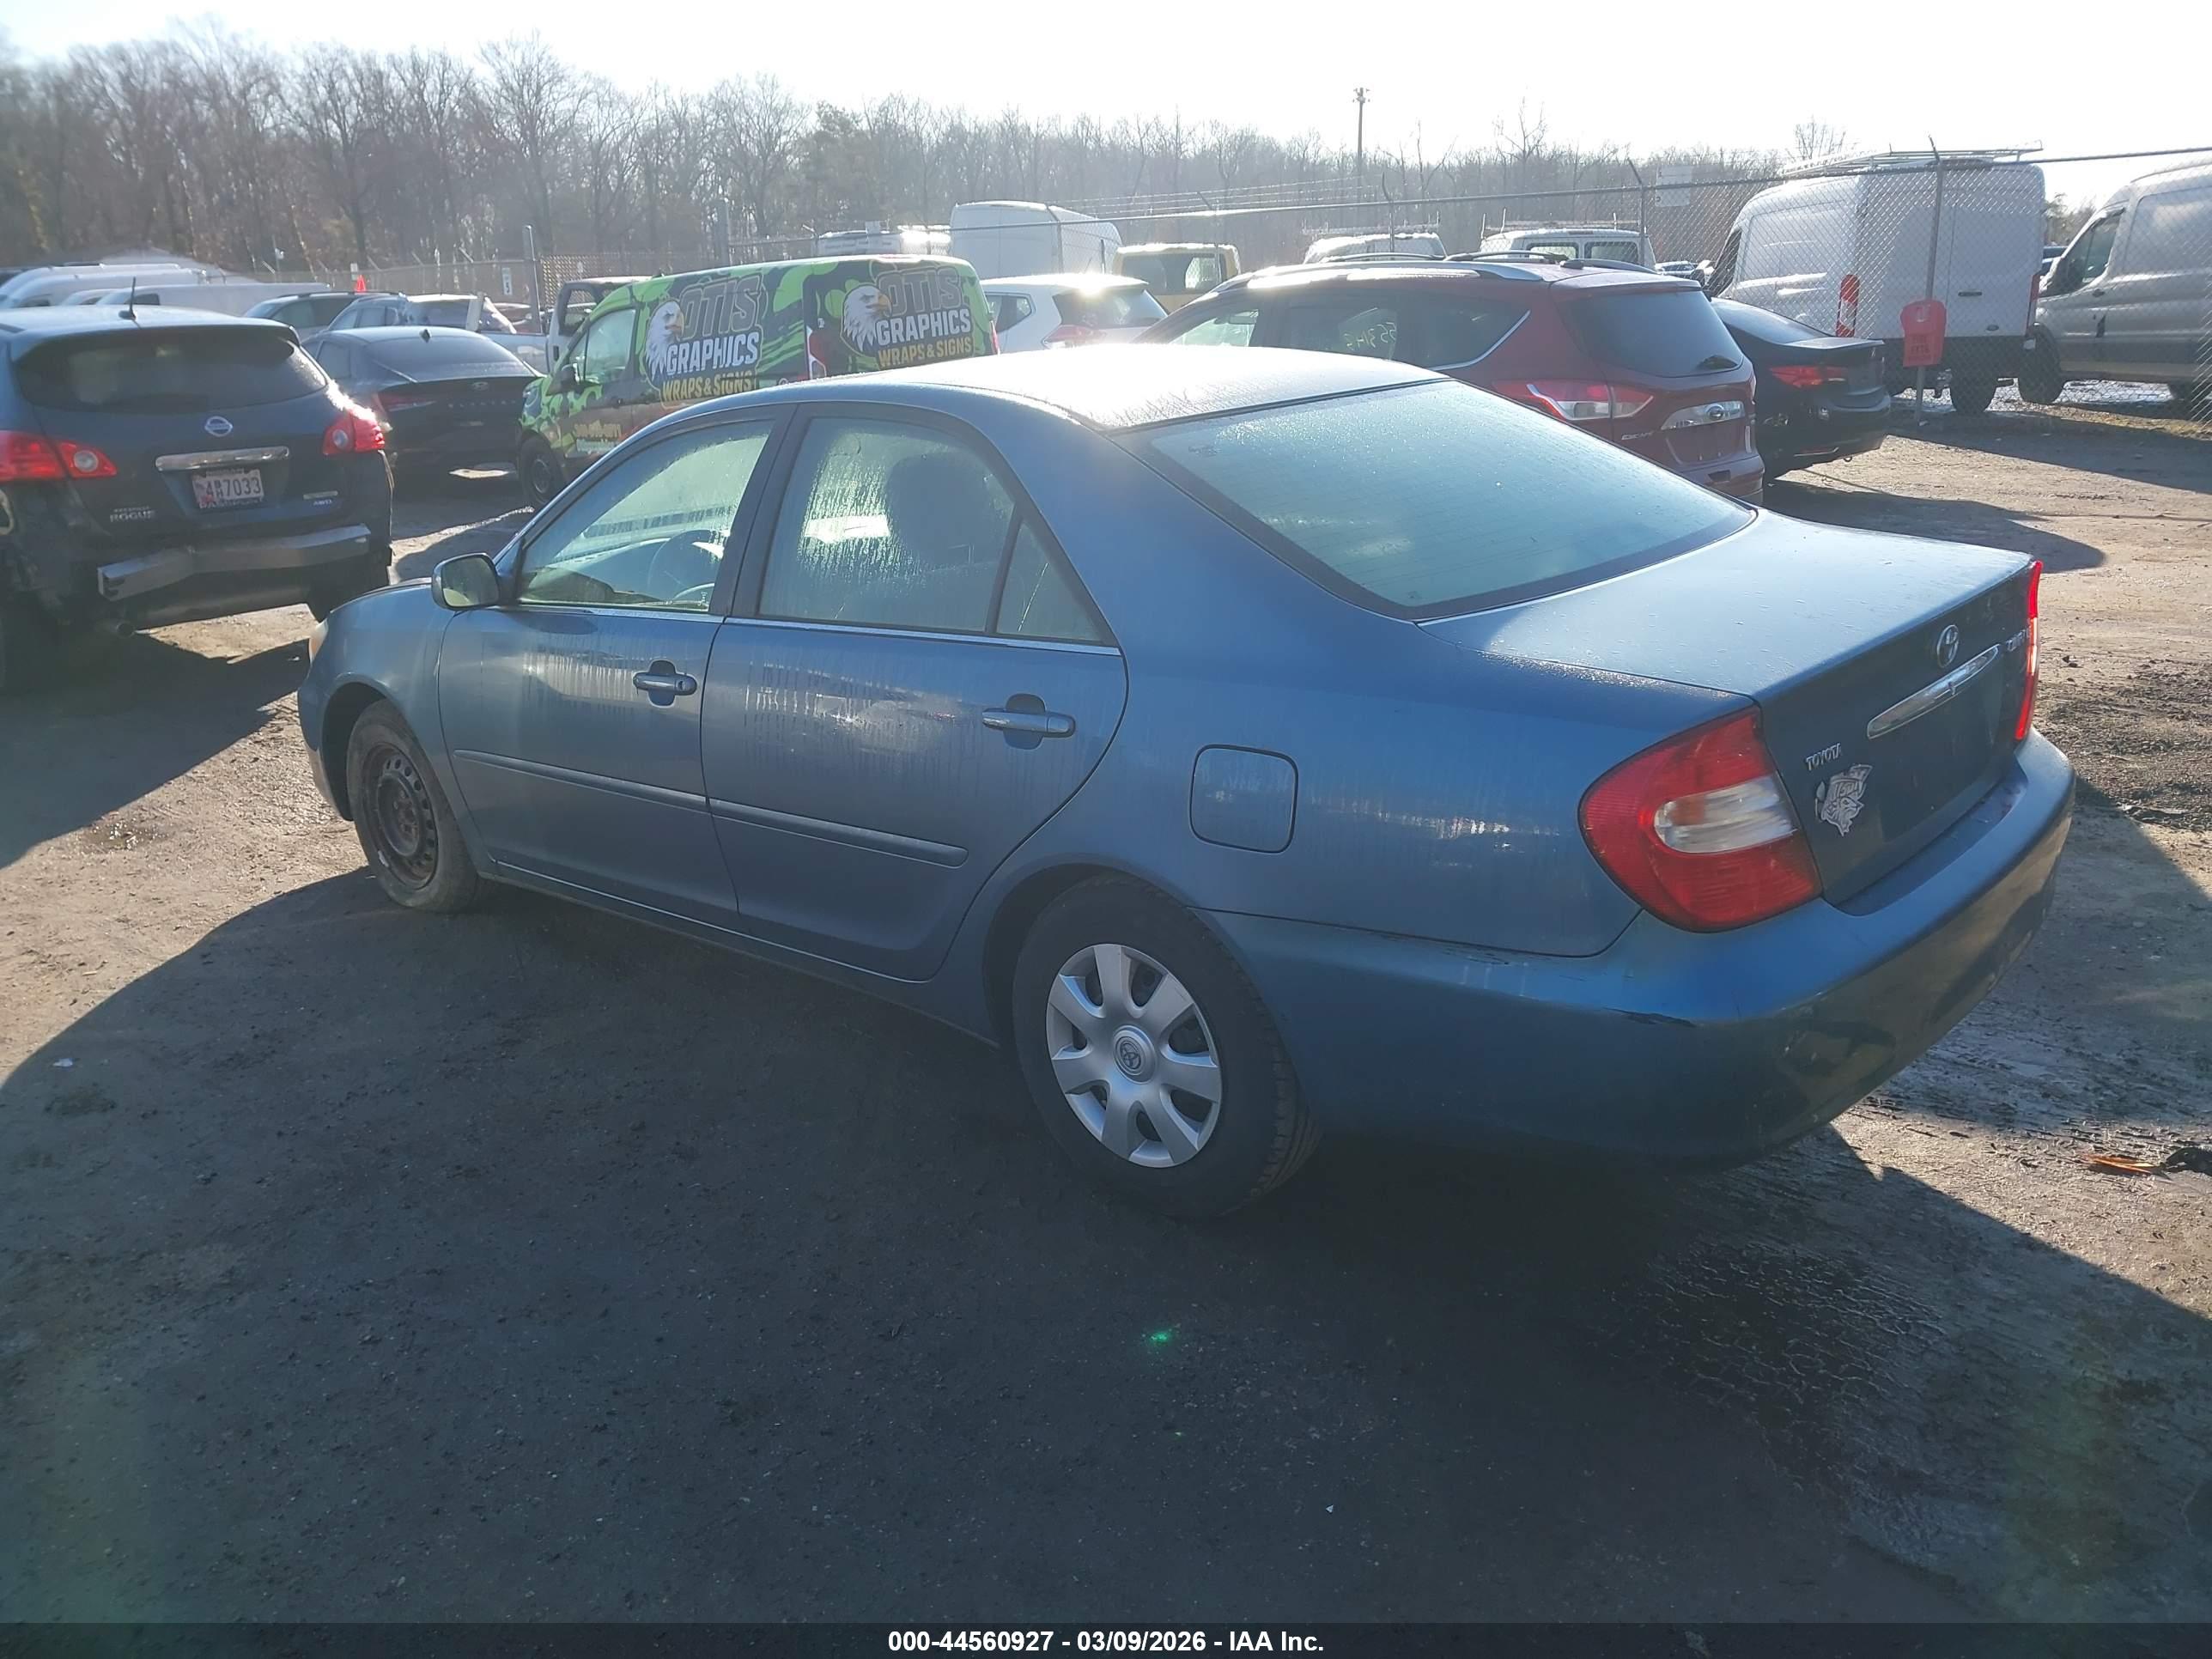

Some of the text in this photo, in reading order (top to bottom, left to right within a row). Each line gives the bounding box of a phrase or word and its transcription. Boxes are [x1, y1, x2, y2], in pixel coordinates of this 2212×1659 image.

[680, 275, 761, 342] OTIS
[878, 267, 961, 318] OTIS
[876, 308, 971, 346] GRAPHICS
[665, 331, 760, 376] GRAPHICS
[878, 336, 973, 368] WRAPS & SIGNS
[662, 369, 753, 403] WRAPS & SIGNS
[1806, 742, 1843, 771] TOYOTA
